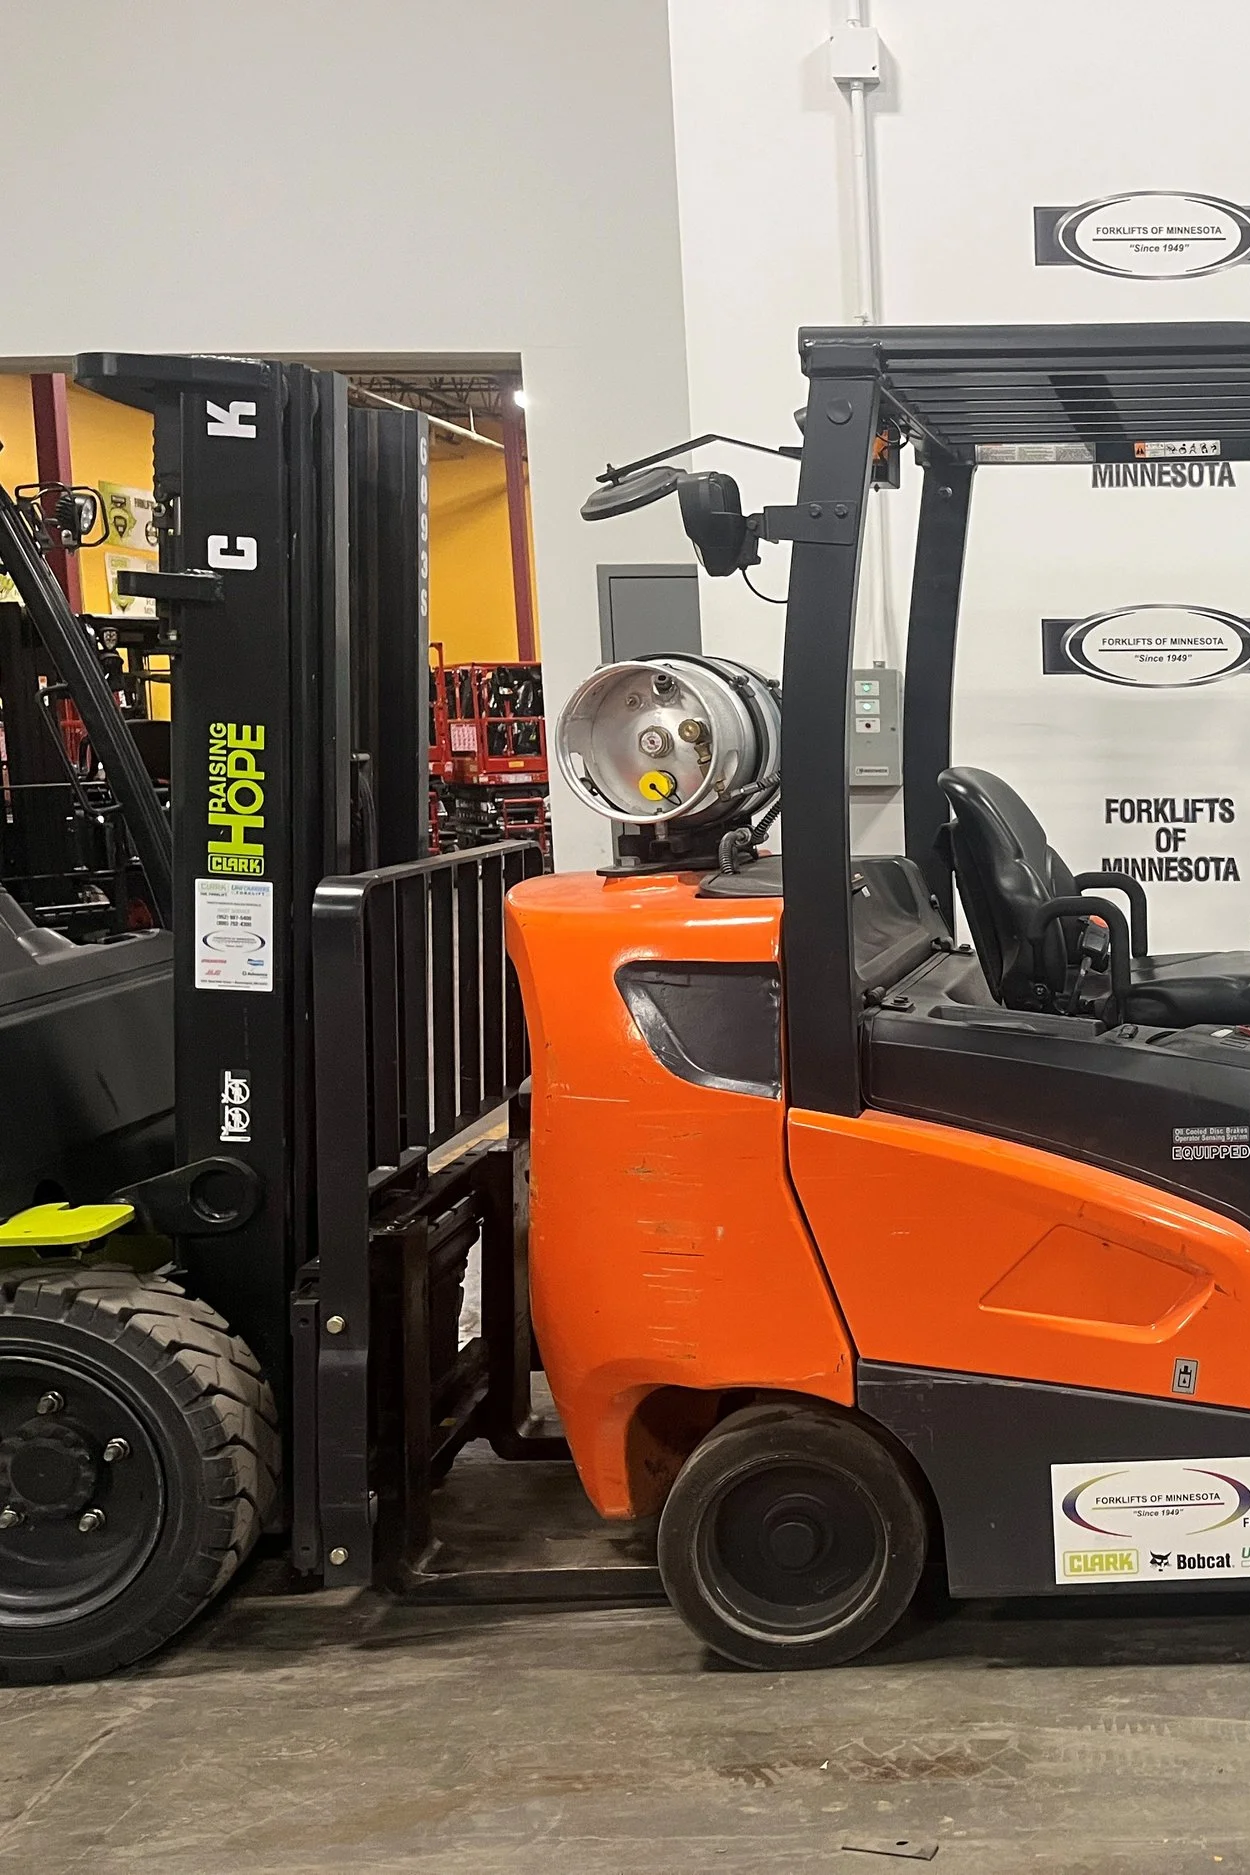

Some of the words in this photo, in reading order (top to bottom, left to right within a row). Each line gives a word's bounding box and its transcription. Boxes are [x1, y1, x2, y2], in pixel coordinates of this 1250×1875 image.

[1096, 226, 1149, 235] FORKLIFTS
[1151, 226, 1164, 235] OF
[1166, 226, 1222, 235] MINNESOTA
[206, 400, 256, 438] K
[1091, 462, 1236, 488] MINNESOTA
[208, 534, 257, 571] C
[1102, 637, 1152, 646] FORKLIFTS
[1155, 637, 1168, 646] OF
[1170, 637, 1224, 646] MINNESOTA
[208, 722, 227, 812] RAISING
[208, 723, 265, 856] HOPE
[1105, 798, 1235, 824] FORKLIFTS
[1155, 827, 1187, 853] OF
[212, 856, 260, 873] CLARK
[1101, 857, 1241, 882] MINNESOTA
[1174, 1135, 1200, 1143] Operator
[1172, 1145, 1250, 1160] EQUIPPED
[1095, 1495, 1148, 1505] FORKLIFTS
[1150, 1494, 1163, 1503] OF
[1165, 1492, 1221, 1502] MINNESOTA
[1069, 1552, 1134, 1573] CLARK
[1177, 1552, 1231, 1570] Bobcat
